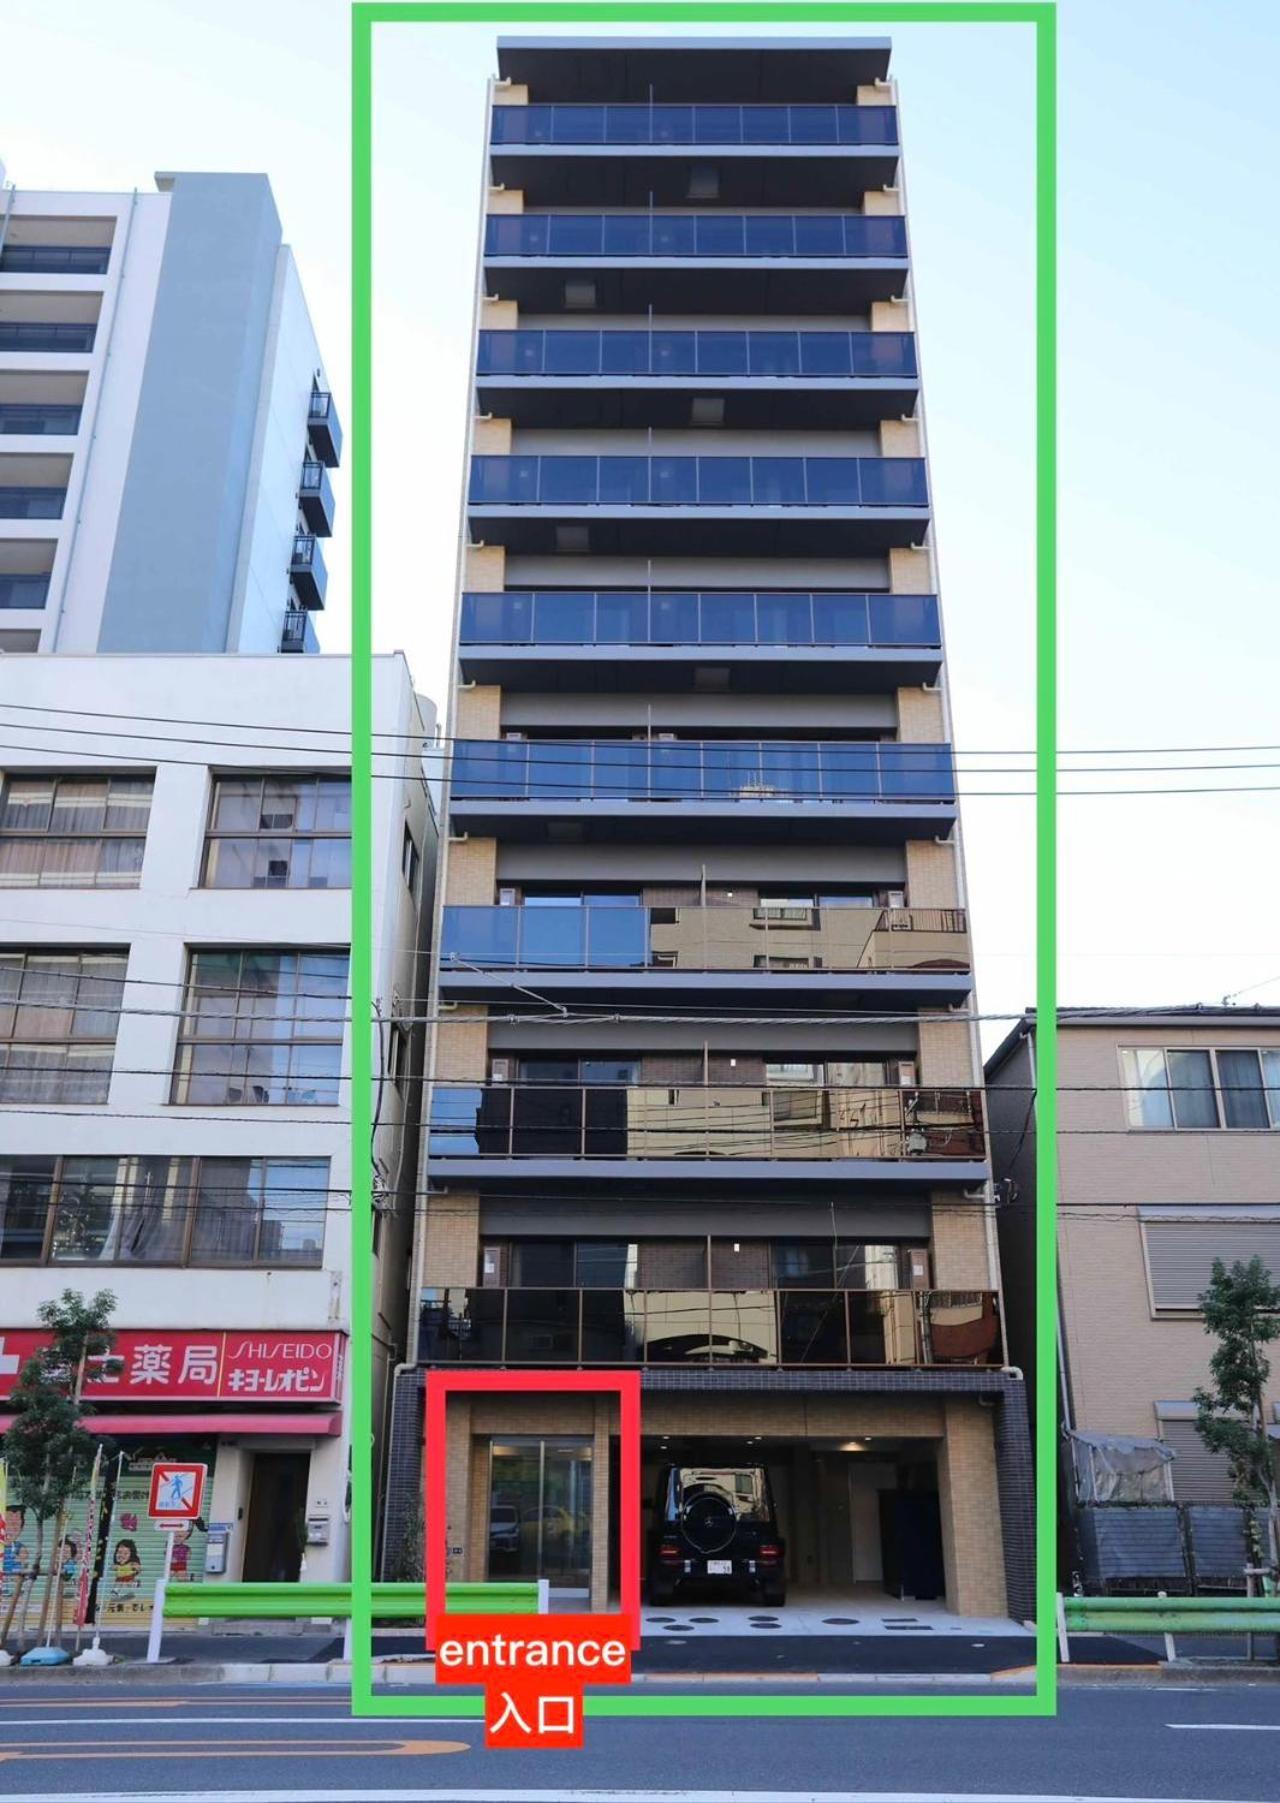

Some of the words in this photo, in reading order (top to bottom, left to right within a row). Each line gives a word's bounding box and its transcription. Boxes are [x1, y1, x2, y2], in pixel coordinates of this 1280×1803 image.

[40, 1344, 217, 1384] 士薬局
[227, 1340, 332, 1359] SHISEIDO
